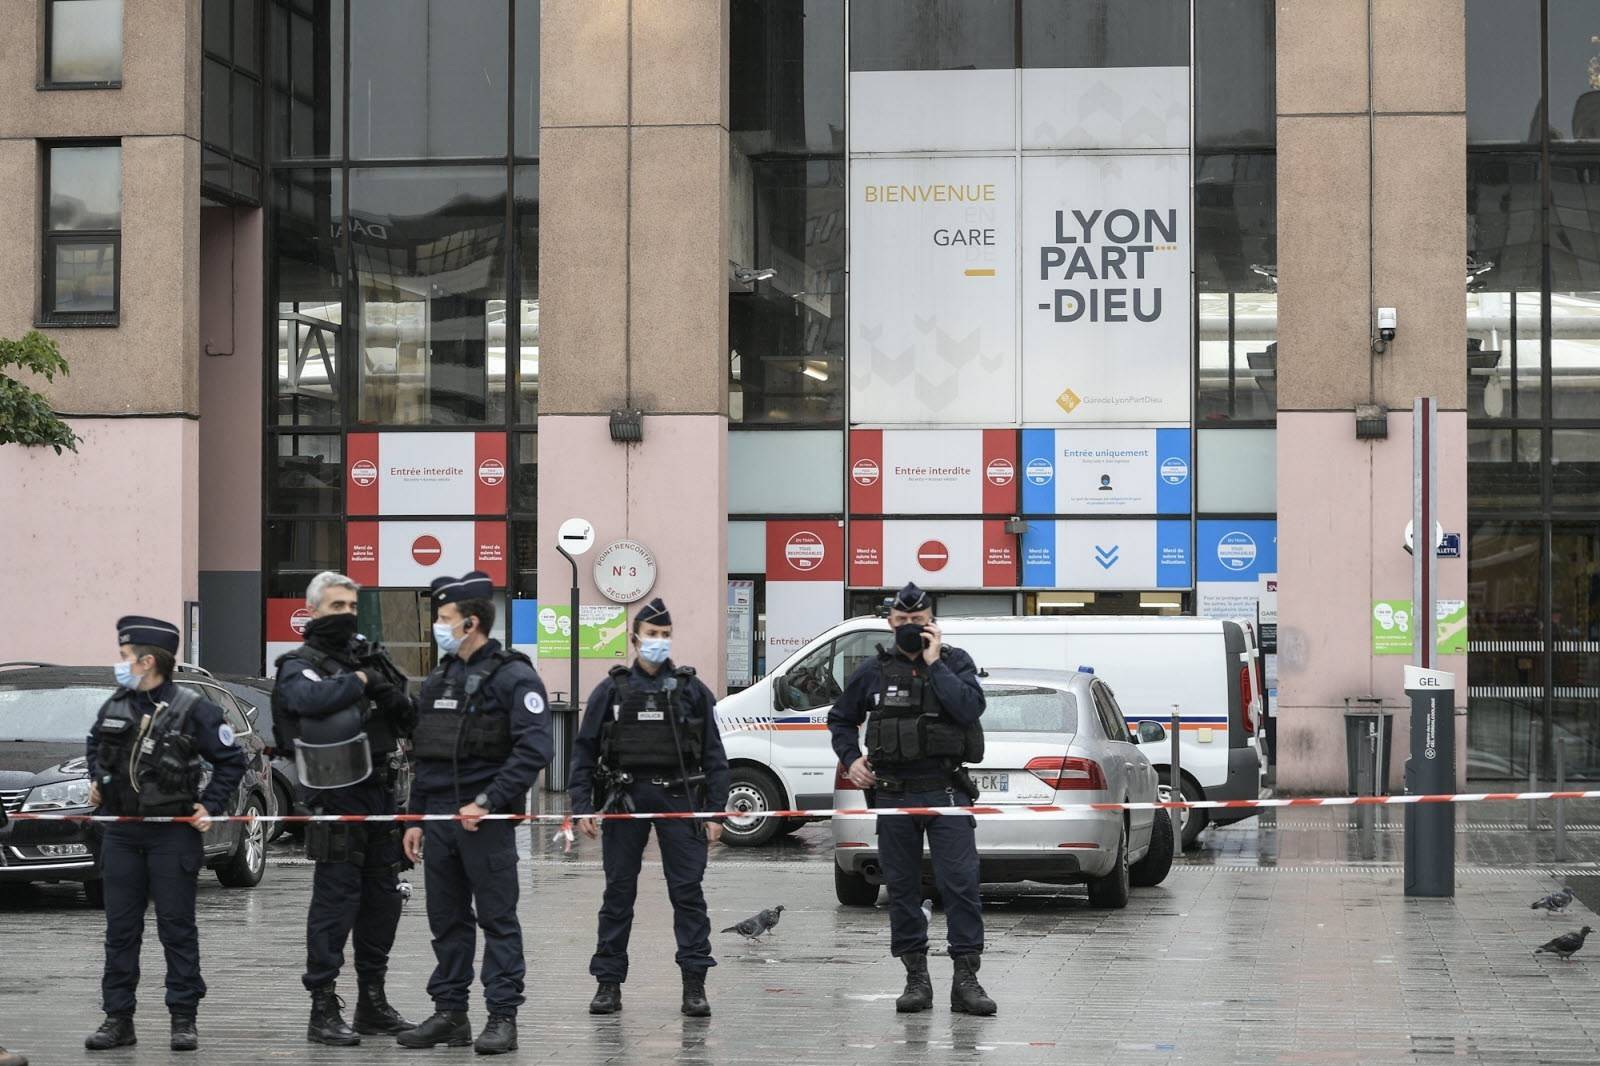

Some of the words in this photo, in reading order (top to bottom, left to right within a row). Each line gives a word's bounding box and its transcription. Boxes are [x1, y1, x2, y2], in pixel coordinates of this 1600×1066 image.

[865, 184, 995, 202] BIENVENUE
[1055, 208, 1177, 244] LYON
[933, 229, 995, 246] GARE
[1040, 245, 1154, 280] PART
[1039, 288, 1162, 323] -DIEU
[1064, 449, 1093, 457] Entrée
[1096, 449, 1149, 459] uniquement
[390, 467, 421, 476] Entrée
[423, 467, 464, 476] interdite
[895, 466, 927, 475] Entrée
[929, 466, 971, 475] interdite
[597, 547, 614, 566] POINT
[615, 543, 653, 567] RENCONTRE
[628, 566, 636, 576] 3
[606, 587, 641, 599] SECOURS
[770, 637, 799, 646] Entrée
[1419, 677, 1441, 687] GEL
